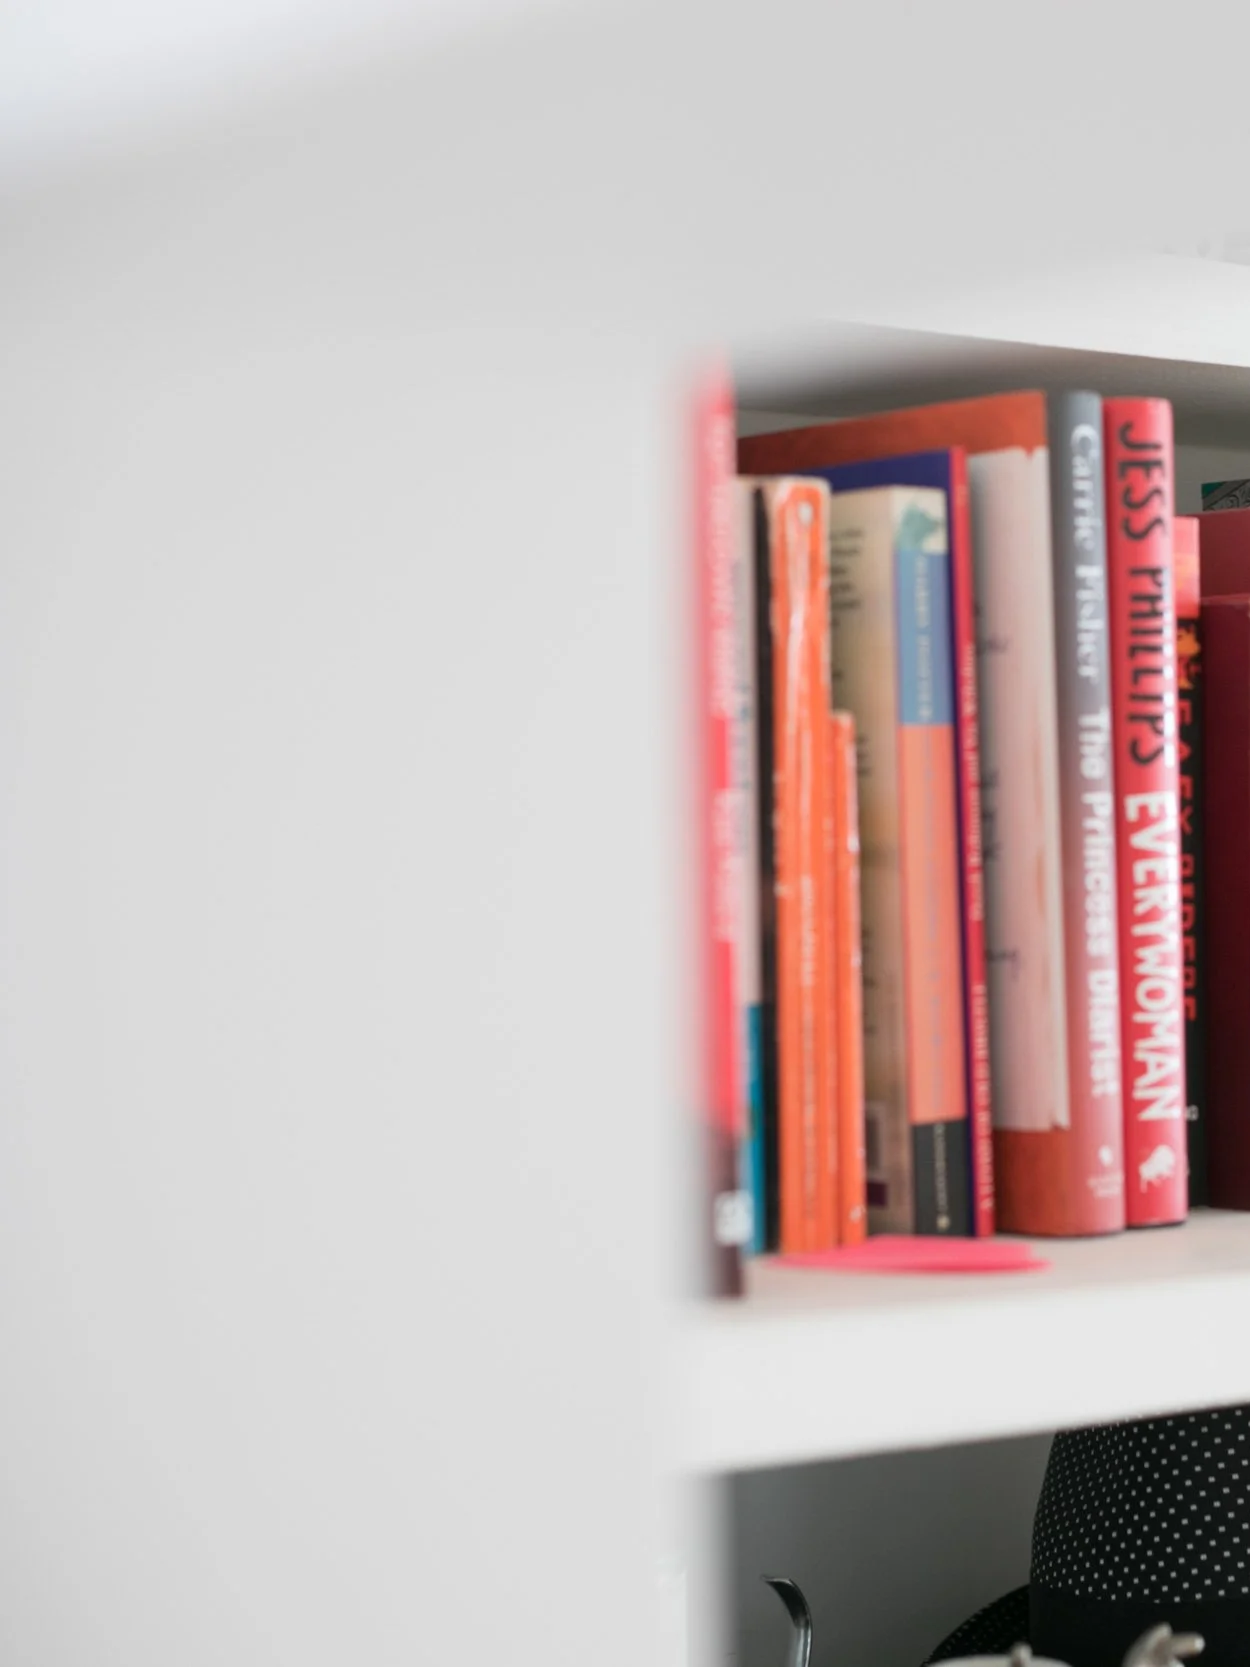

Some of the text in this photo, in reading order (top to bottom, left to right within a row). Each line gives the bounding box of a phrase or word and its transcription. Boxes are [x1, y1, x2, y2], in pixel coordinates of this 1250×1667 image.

[1070, 423, 1120, 1098] Carrie Fisher The Princess Diarist
[1118, 421, 1183, 1123] JESS PHILLIPS EVERYWOMAN
